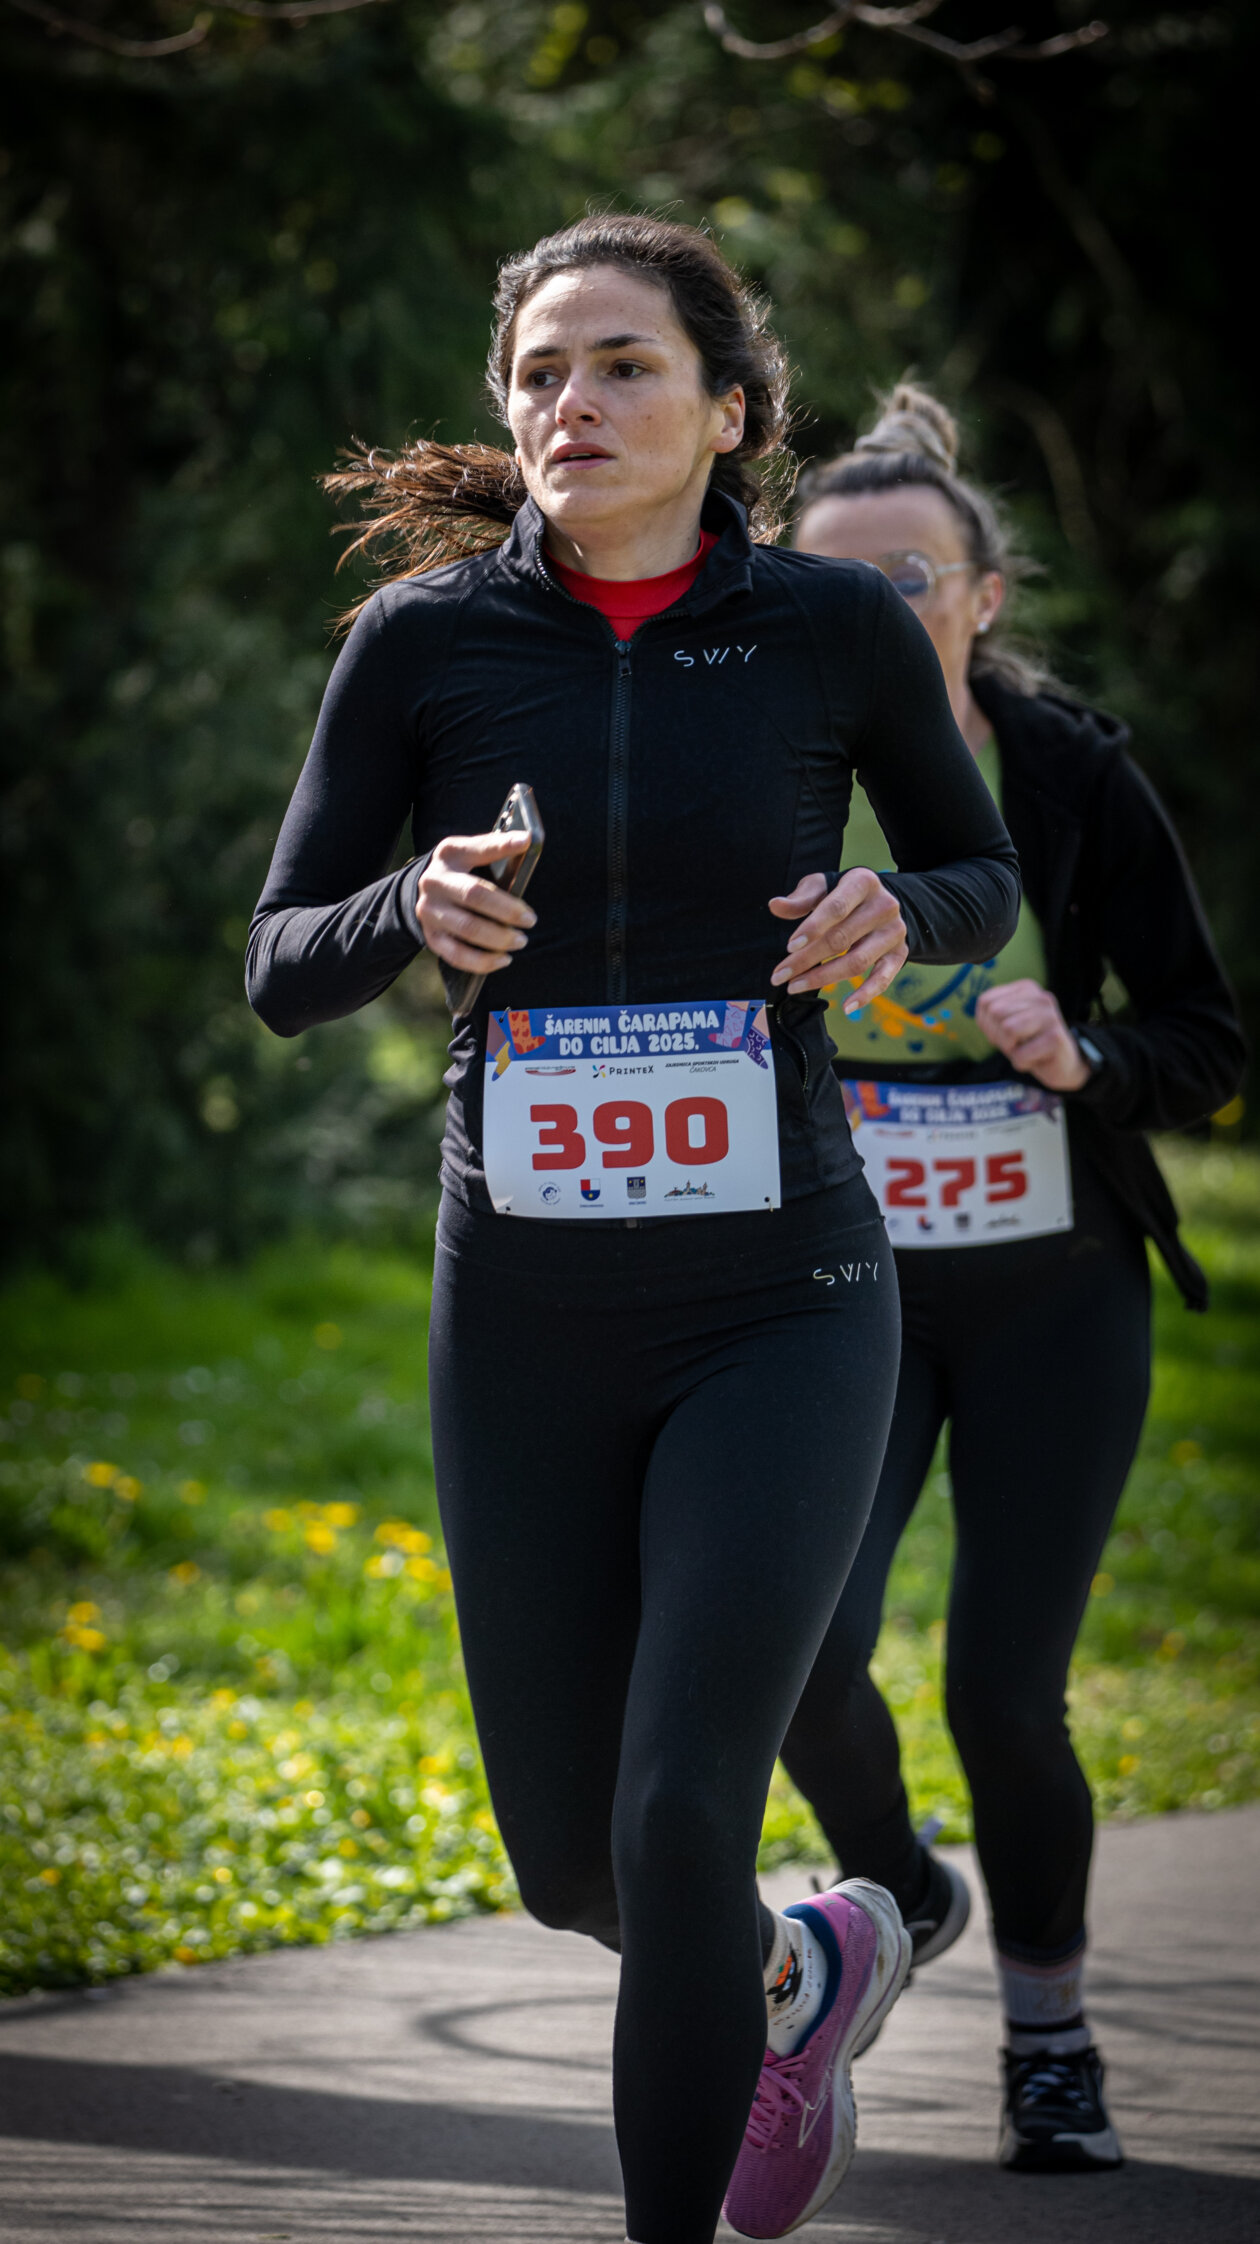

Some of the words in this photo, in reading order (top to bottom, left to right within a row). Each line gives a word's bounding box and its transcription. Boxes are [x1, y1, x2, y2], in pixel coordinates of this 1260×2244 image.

[673, 644, 758, 668] SWY
[544, 1013, 611, 1036] ŠARENIM
[617, 1009, 720, 1034] ČARAPAMA
[559, 1036, 584, 1056] DO
[590, 1034, 641, 1055] CILJA
[647, 1032, 700, 1053] 2025.
[530, 1096, 729, 1171] 390
[884, 1149, 1028, 1208] 275
